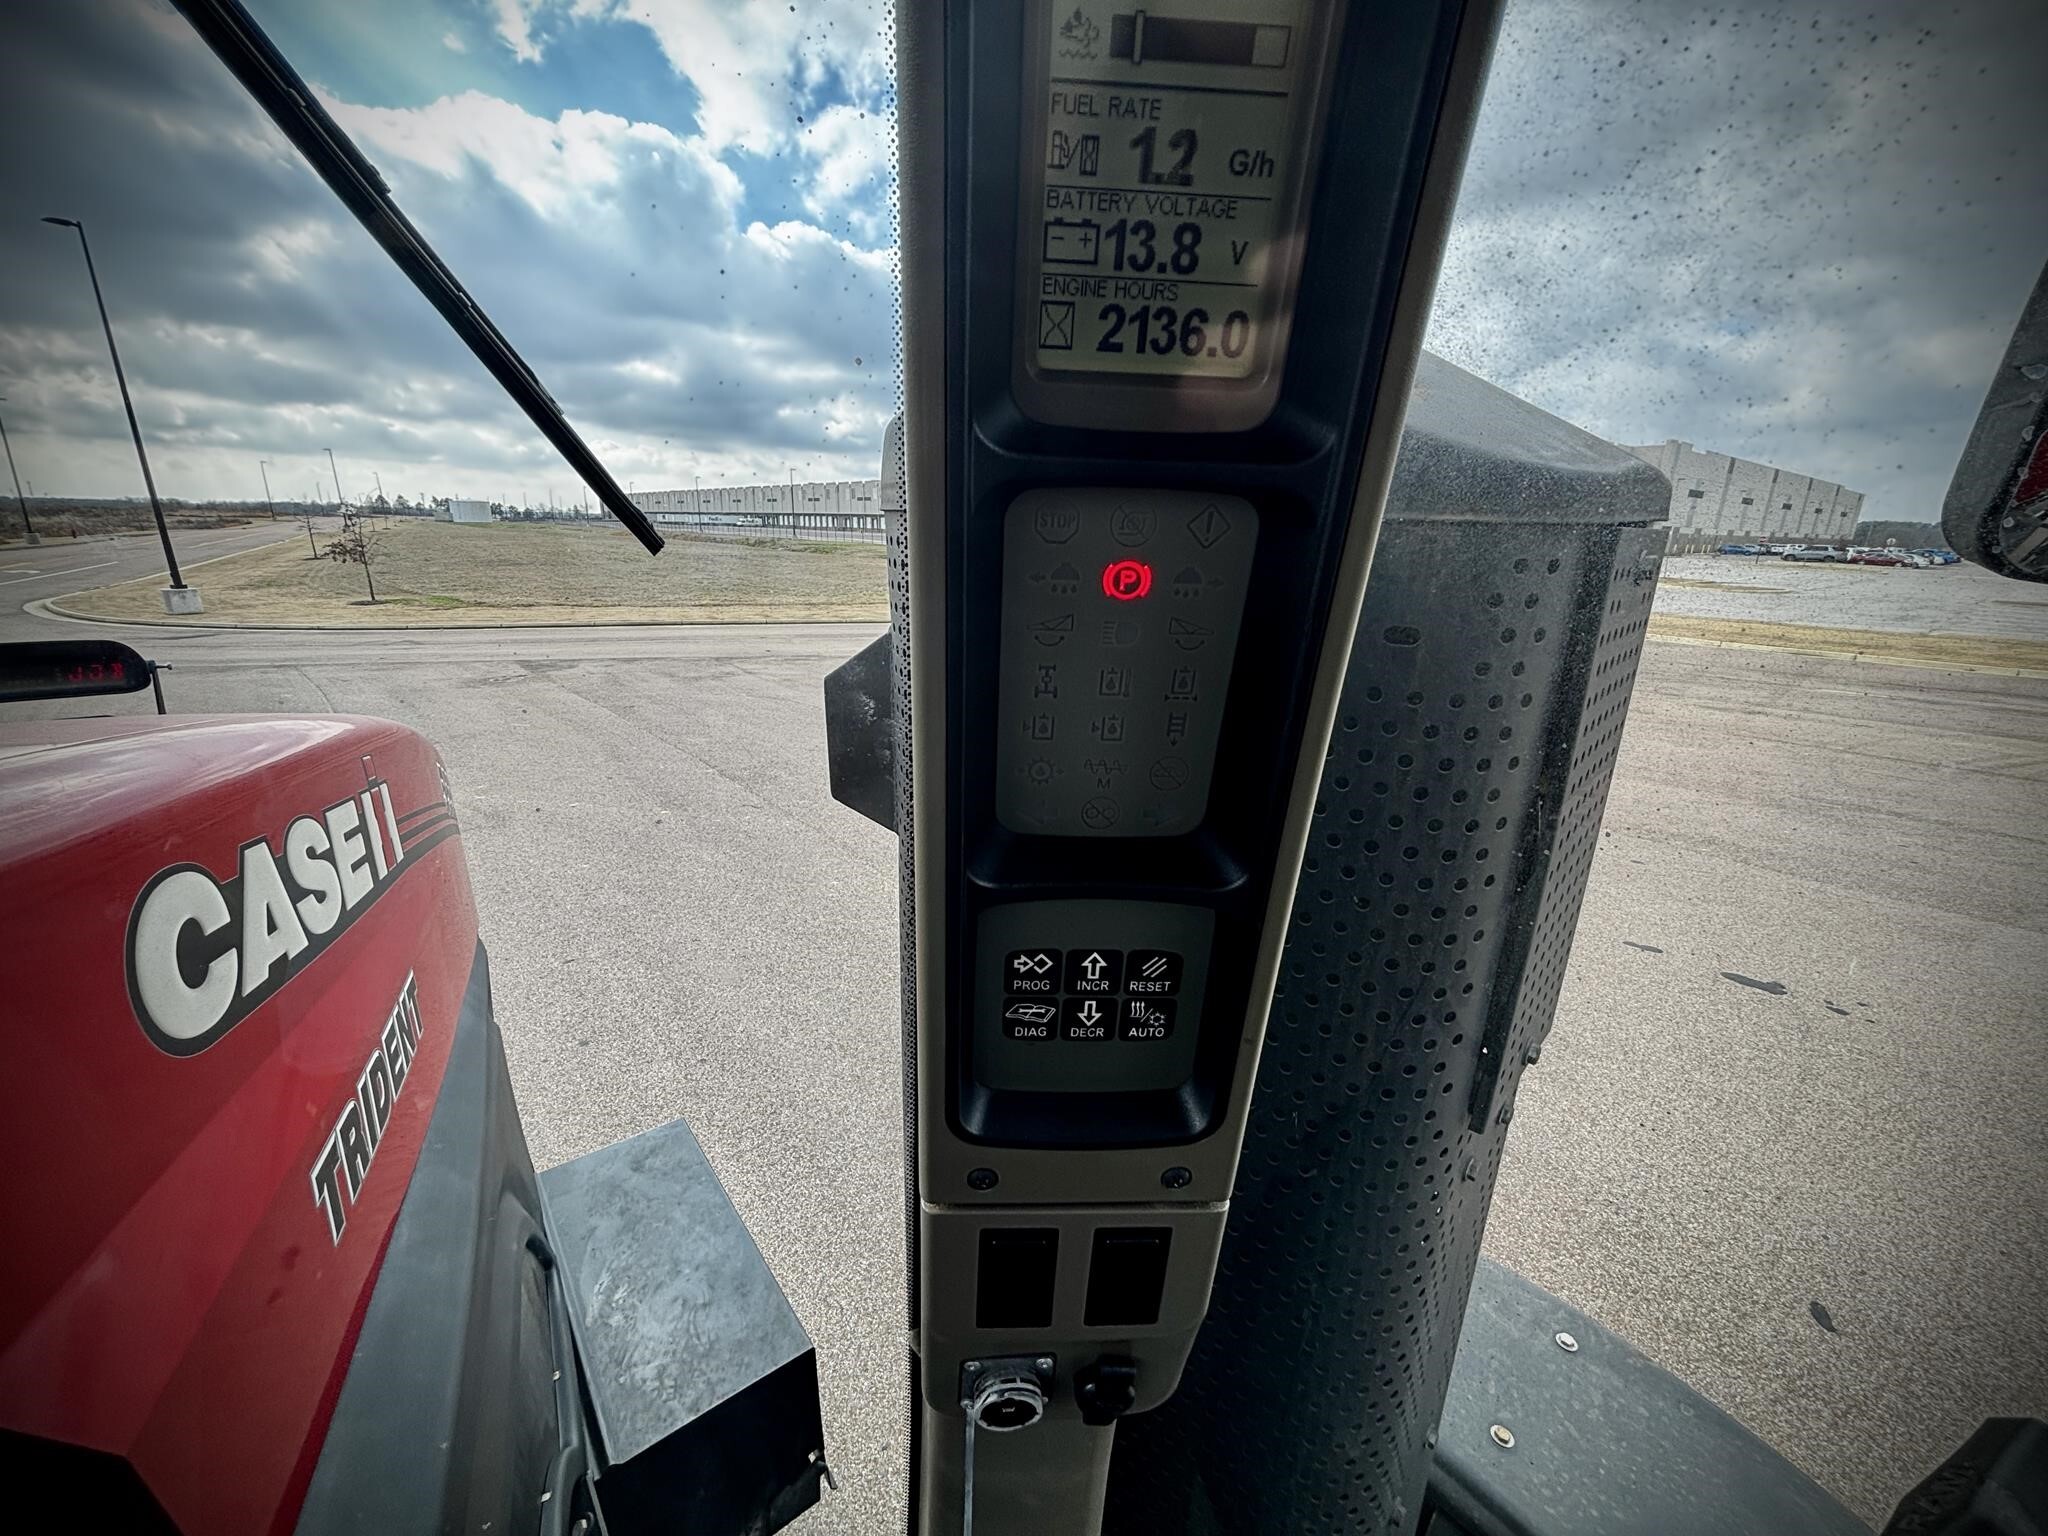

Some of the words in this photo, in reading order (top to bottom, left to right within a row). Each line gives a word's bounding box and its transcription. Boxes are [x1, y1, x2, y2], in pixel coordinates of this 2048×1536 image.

[1051, 93, 1099, 117] FUEL
[1108, 96, 1162, 120] RATE
[1129, 126, 1199, 187] 1.2
[1229, 149, 1274, 178] G/h
[1046, 189, 1136, 213] BATTERY
[1146, 194, 1238, 219] VOLTAGE
[1105, 219, 1202, 275] 13.8
[1231, 240, 1249, 265] V
[1042, 276, 1107, 299] ENGINE
[1114, 281, 1178, 301] HOURS
[1096, 303, 1251, 358] 2136.0
[1039, 512, 1077, 530] STOP
[1013, 980, 1050, 991] PROG
[1077, 980, 1109, 991] INCR
[1129, 981, 1171, 992] RESET
[1014, 1027, 1047, 1037] DIAG
[1070, 1027, 1105, 1038] DECR
[1128, 1027, 1165, 1037] AUTO
[310, 967, 424, 1247] TRIDENT
